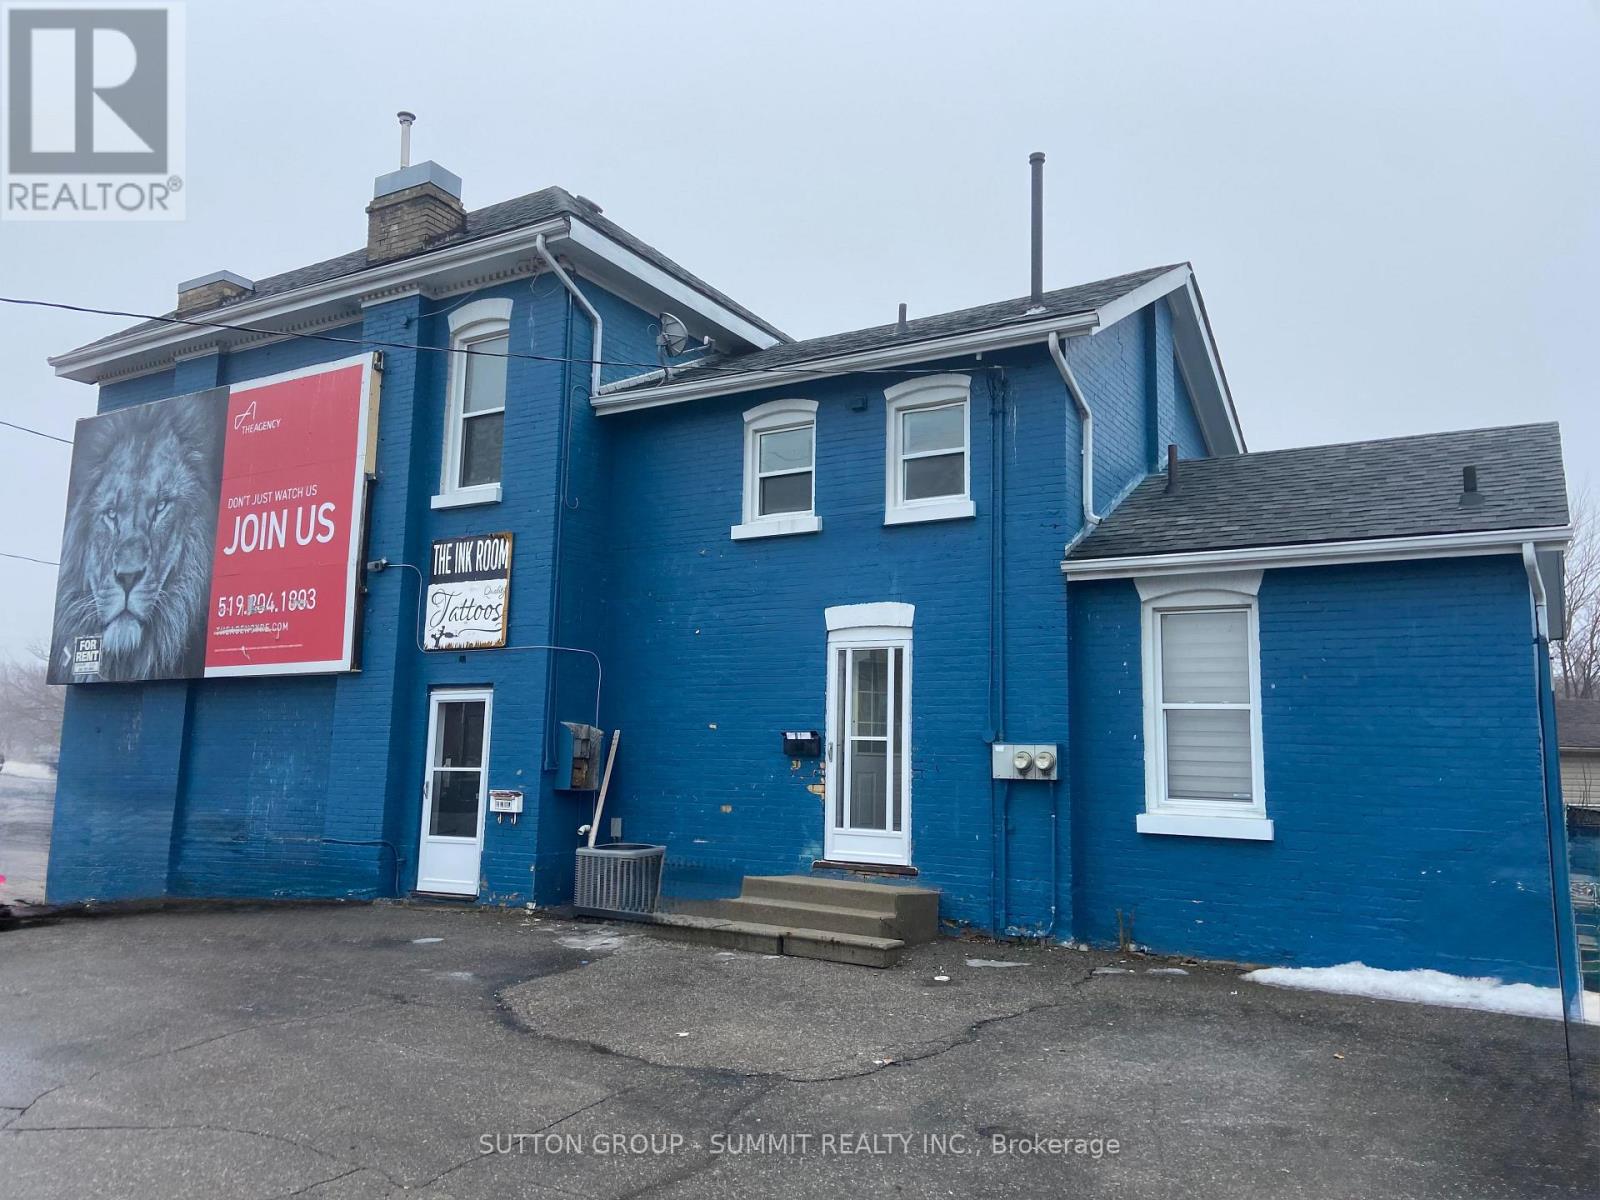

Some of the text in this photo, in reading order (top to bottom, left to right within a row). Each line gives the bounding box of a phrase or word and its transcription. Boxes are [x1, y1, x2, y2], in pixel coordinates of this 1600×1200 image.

[228, 484, 318, 509] DON'T JUST WATCH US
[223, 502, 336, 555] JOIN US
[433, 538, 510, 576] THE INK ROOM
[429, 588, 503, 631] Tattoos
[75, 650, 99, 662] RENT
[80, 639, 97, 651] FOR
